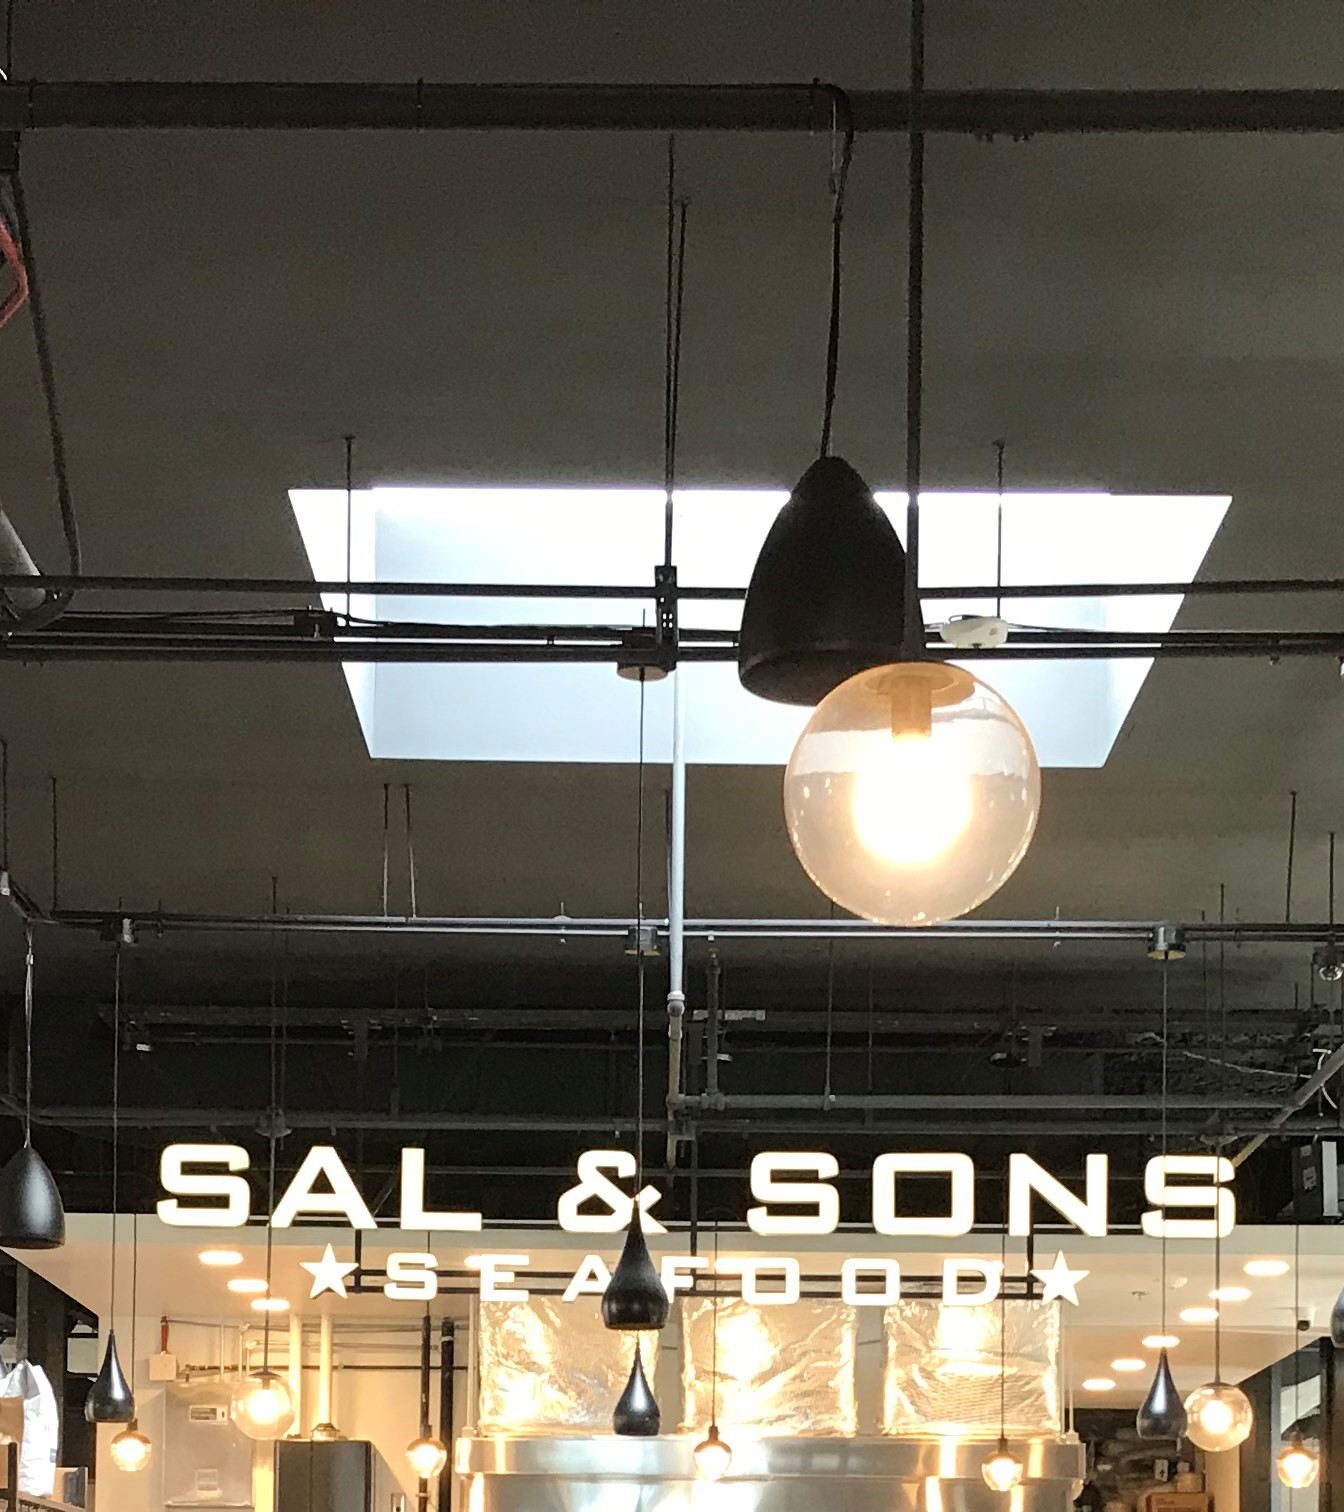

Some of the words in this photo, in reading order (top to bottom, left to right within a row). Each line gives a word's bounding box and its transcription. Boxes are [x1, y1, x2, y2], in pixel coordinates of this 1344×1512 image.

[157, 1144, 482, 1230] SAL
[557, 1150, 668, 1234] &
[747, 1151, 1236, 1238] SONS
[384, 1252, 1004, 1307] SEAFOOD
